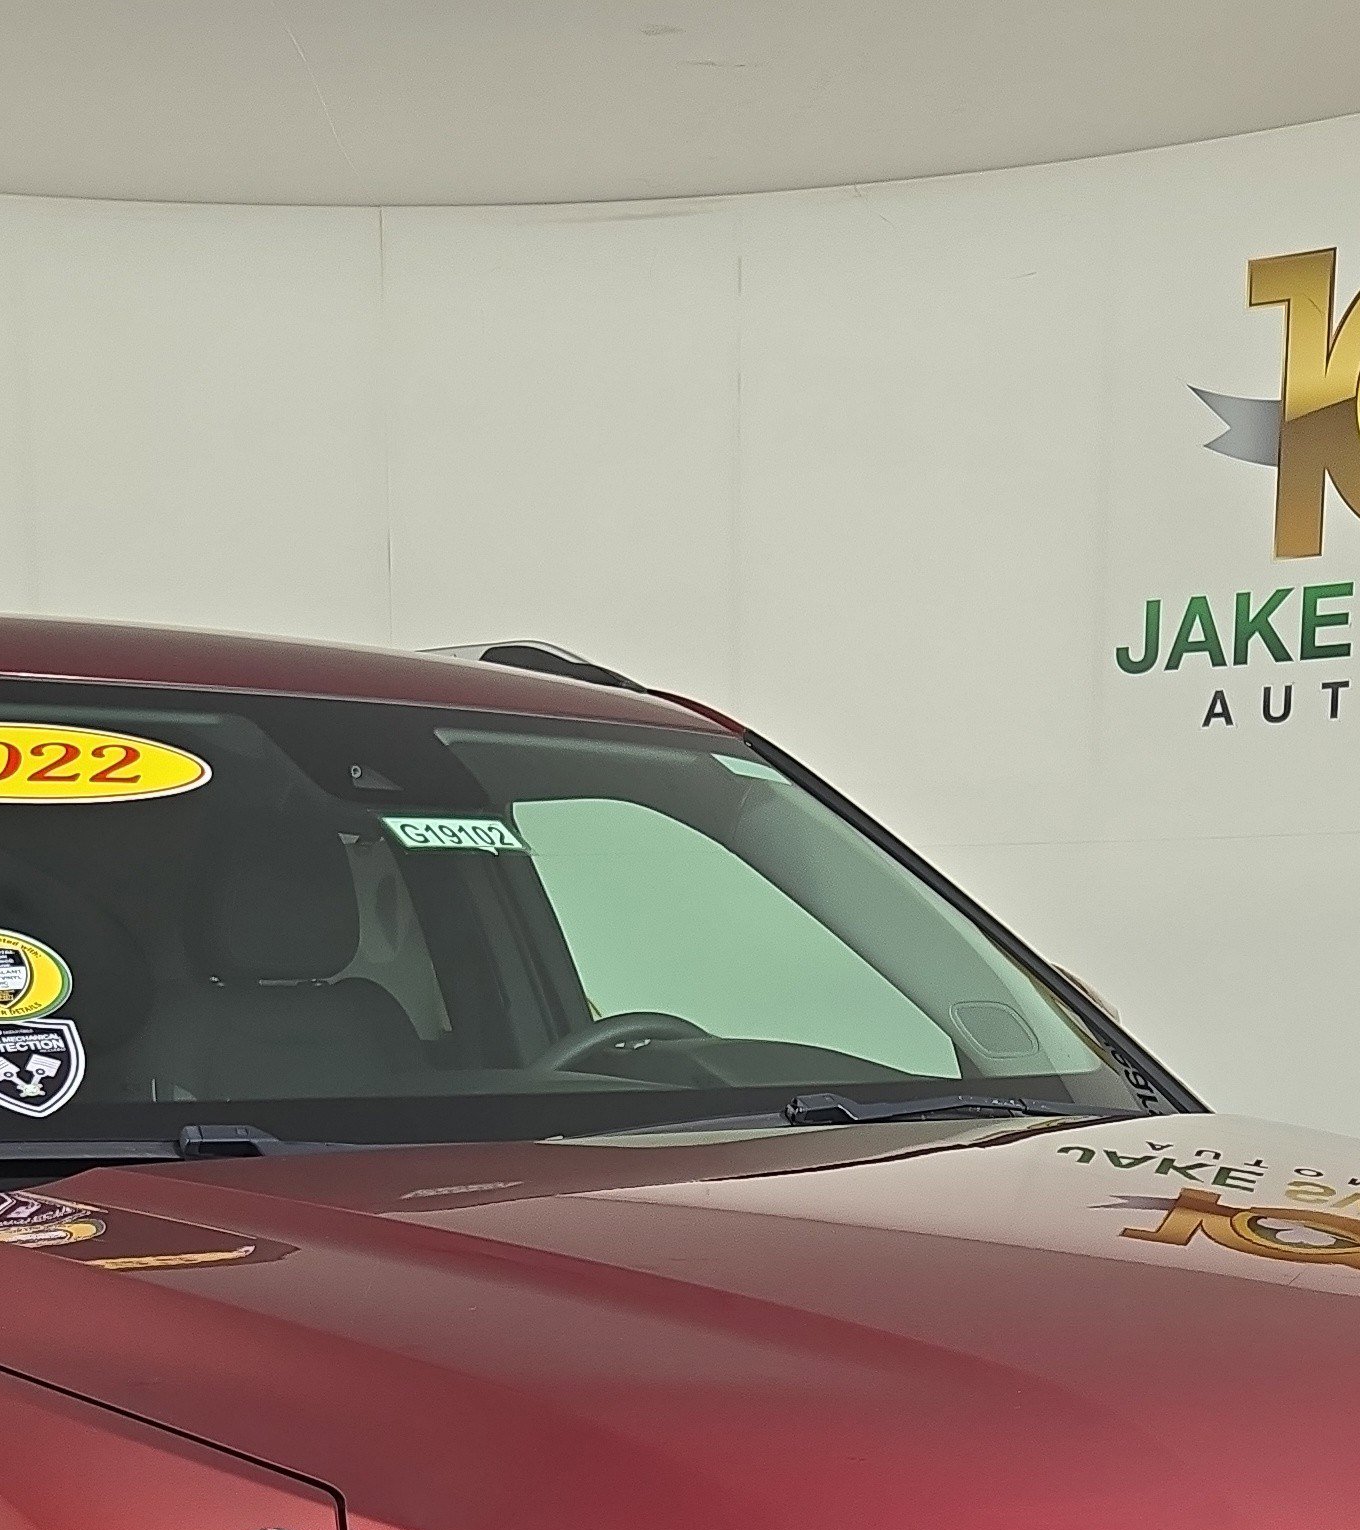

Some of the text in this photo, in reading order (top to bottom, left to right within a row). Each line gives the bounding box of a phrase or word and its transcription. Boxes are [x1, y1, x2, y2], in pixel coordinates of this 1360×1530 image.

[1115, 581, 1355, 675] JAKE
[400, 824, 515, 847] G19102
[9, 1002, 42, 1016] DETAILS
[1, 1033, 62, 1043] MECHANICAL
